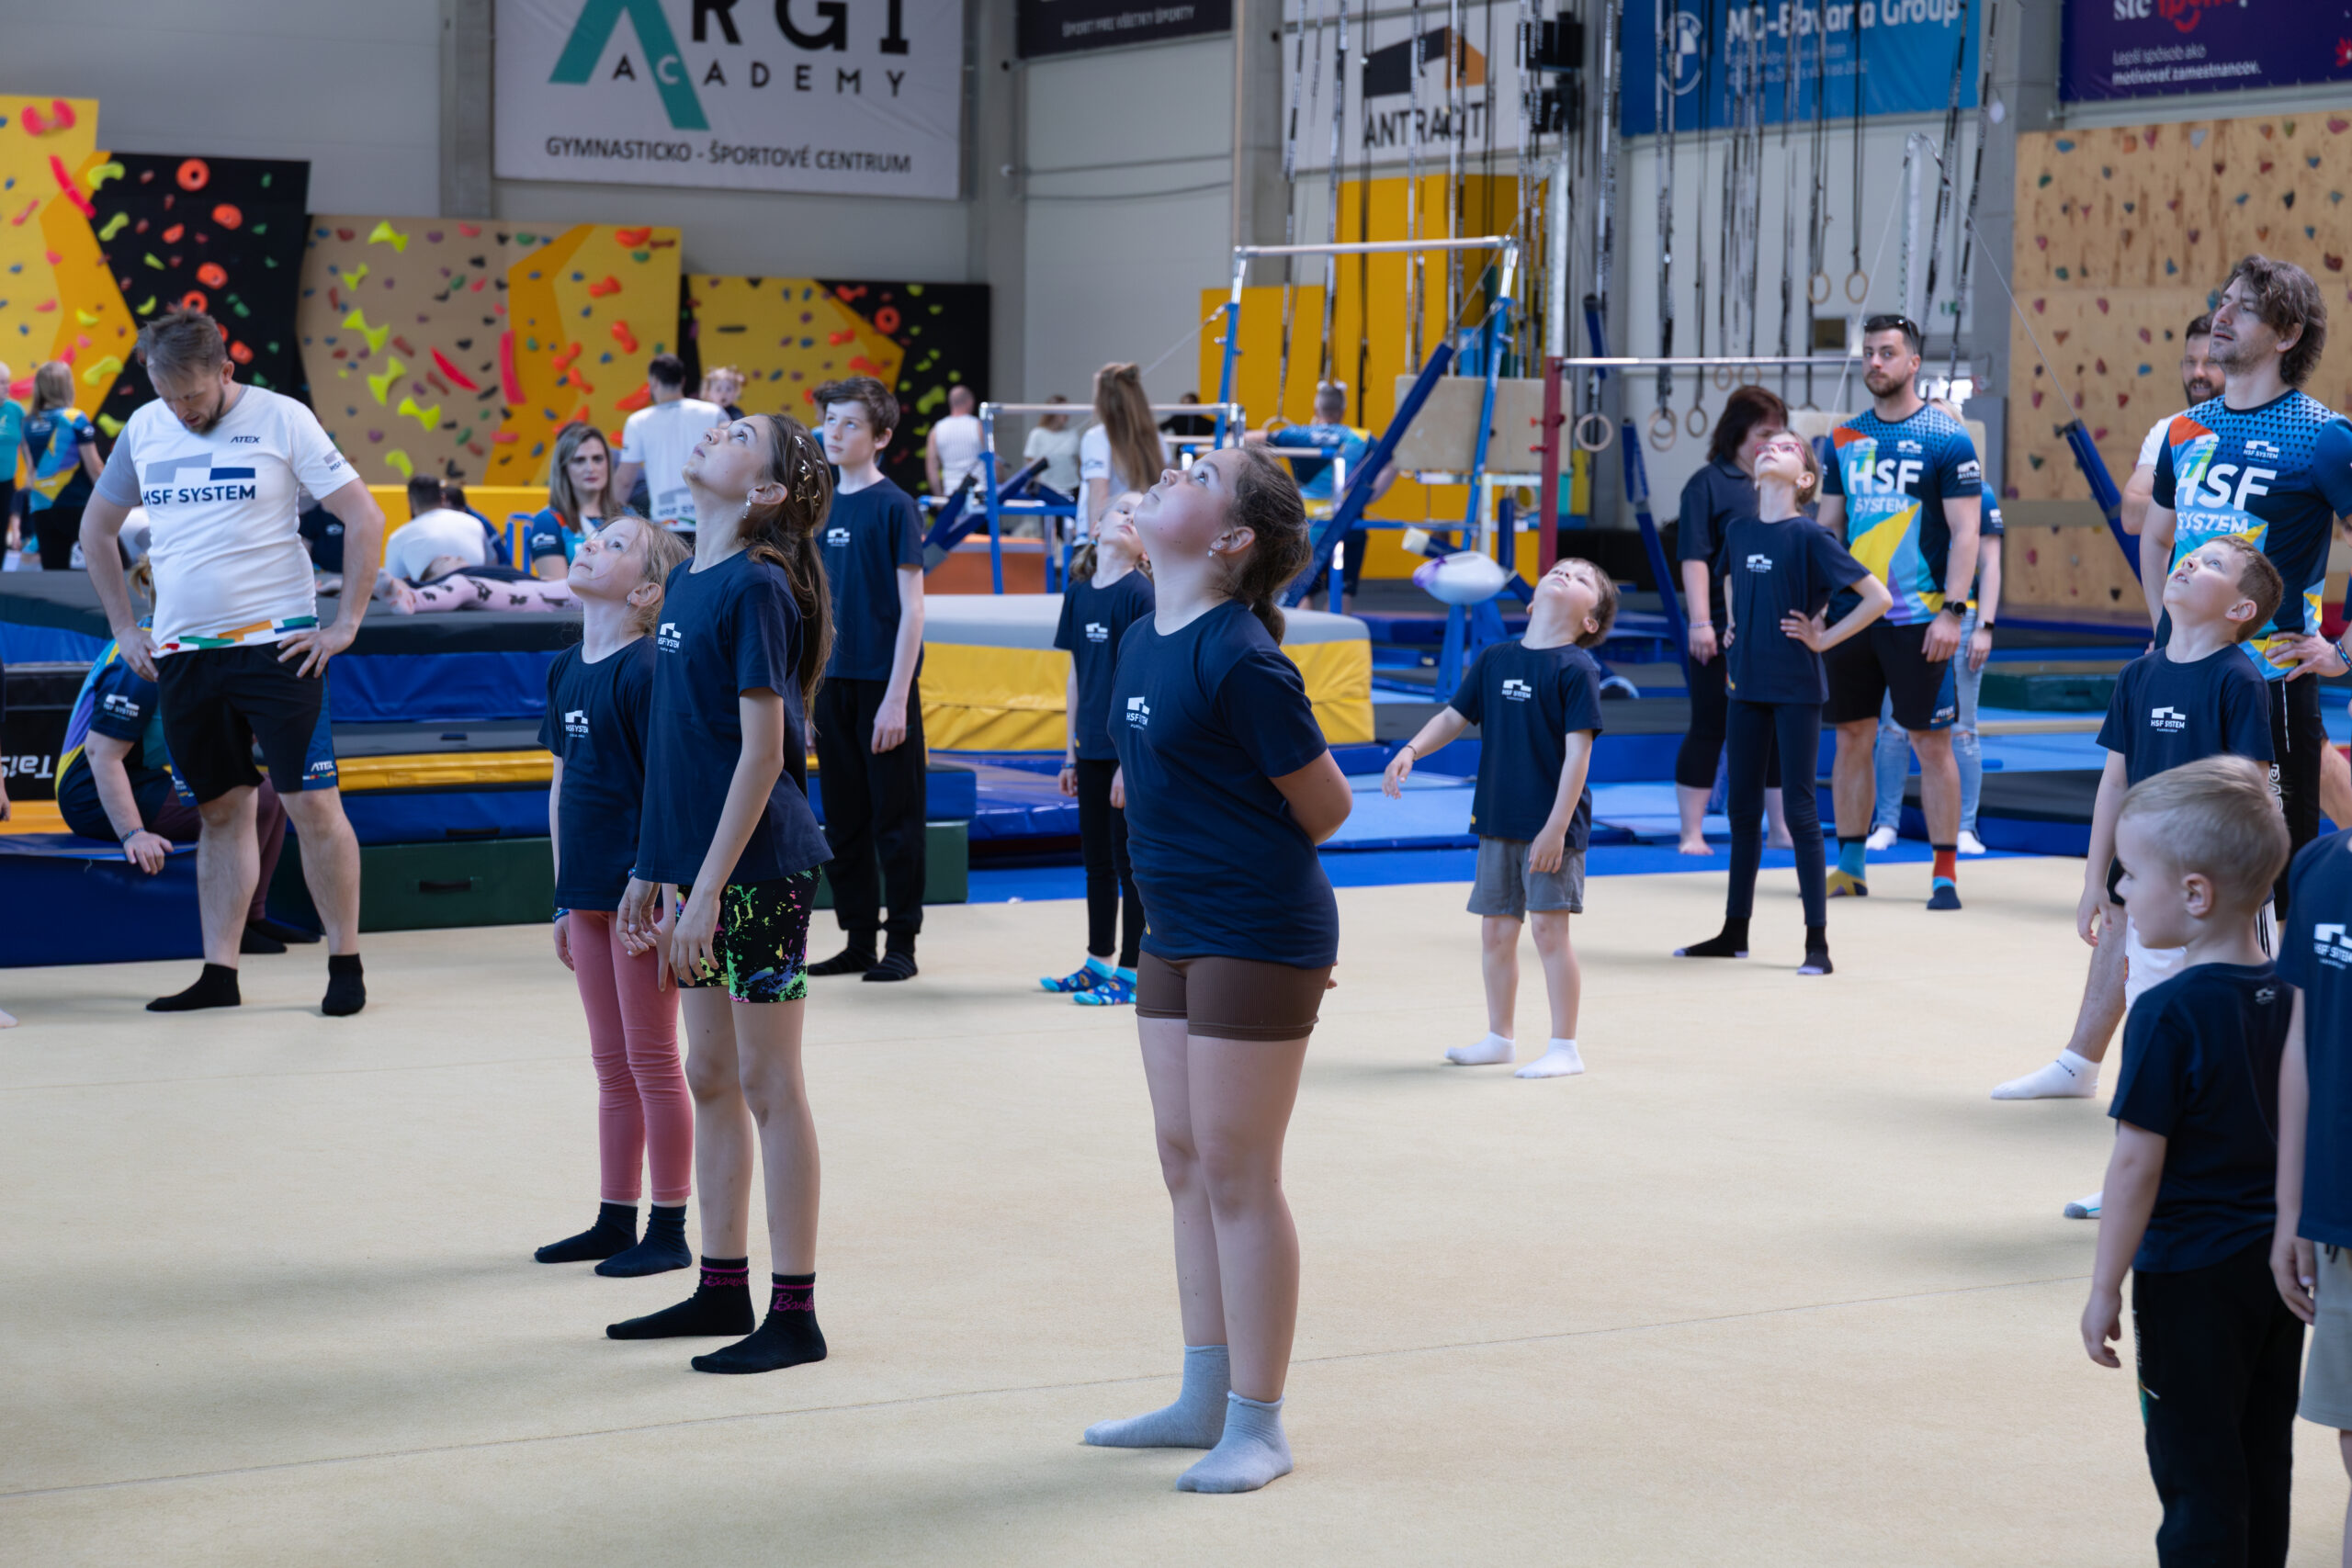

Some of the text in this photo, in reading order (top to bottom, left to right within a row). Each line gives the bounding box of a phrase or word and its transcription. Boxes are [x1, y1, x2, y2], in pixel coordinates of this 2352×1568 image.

[612, 53, 907, 97] ACADEMY
[546, 137, 692, 163] GYMNASTICKO
[708, 140, 809, 169] ŠPORTOVÉ
[815, 150, 911, 174] CENTRUM
[230, 435, 261, 444] ATEX
[1848, 458, 1924, 495] HSF
[2175, 462, 2278, 511] HSF
[178, 485, 256, 503] SYSTEM
[1853, 496, 1909, 513] SYSTEM
[2177, 512, 2249, 535] SYSTEM
[2151, 719, 2165, 728] HSF
